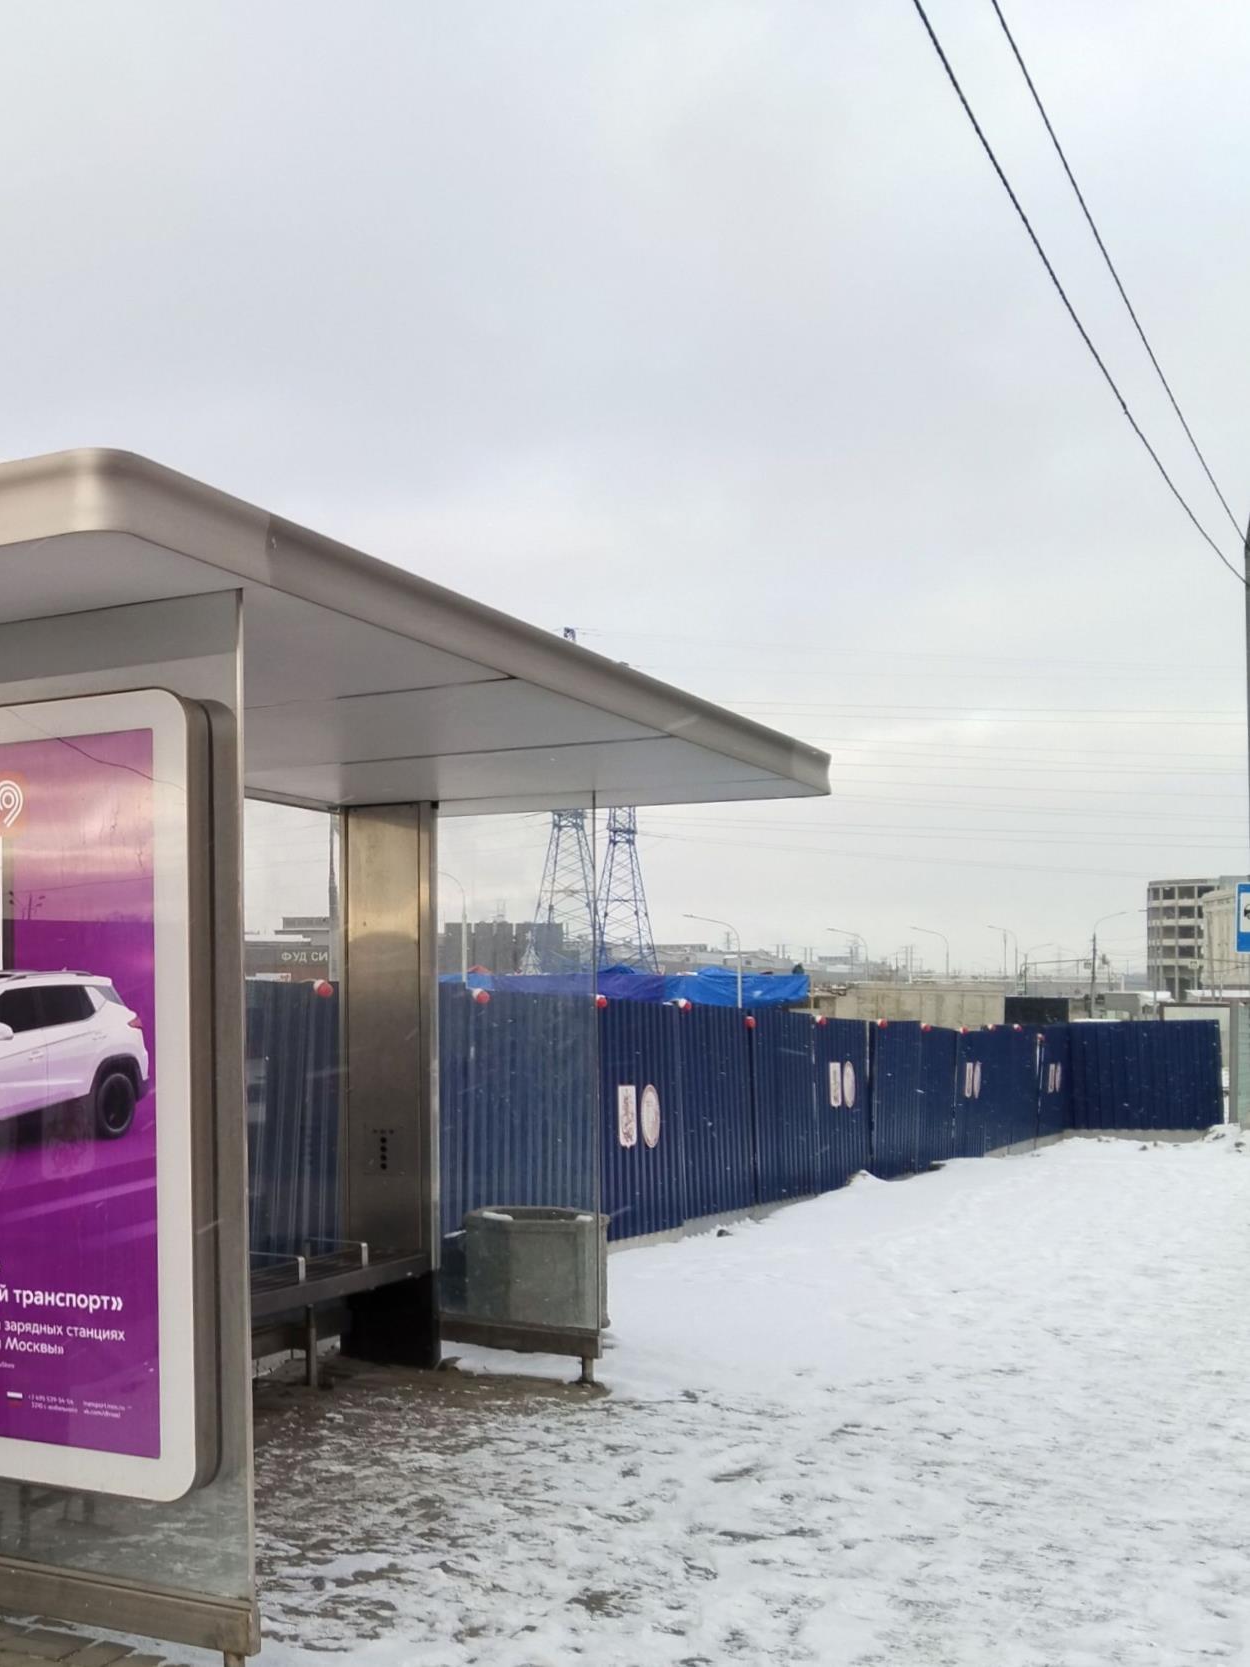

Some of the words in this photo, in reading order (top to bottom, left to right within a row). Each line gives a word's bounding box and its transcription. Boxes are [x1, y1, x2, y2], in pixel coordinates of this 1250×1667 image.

[281, 951, 308, 963] ФУД
[13, 1289, 123, 1313] транспорт»
[4, 1320, 63, 1337] зарядных
[66, 1325, 126, 1342] станциях
[5, 1337, 64, 1355] Москвы»
